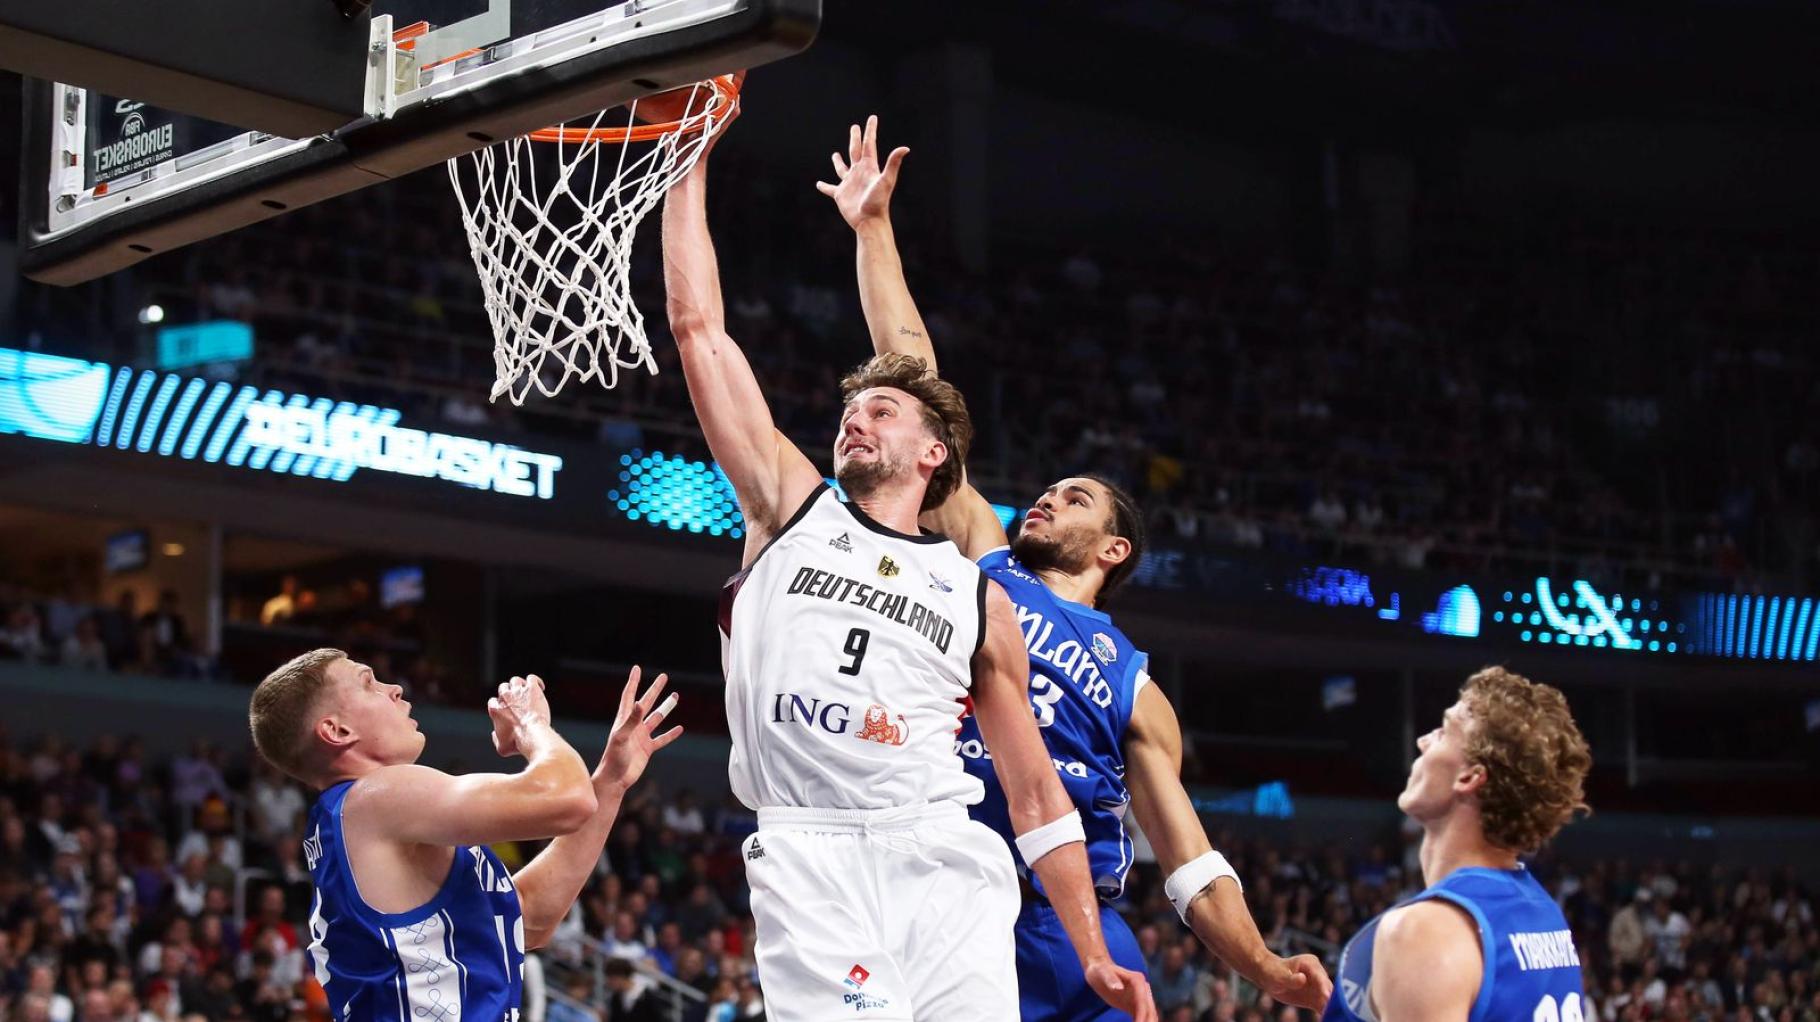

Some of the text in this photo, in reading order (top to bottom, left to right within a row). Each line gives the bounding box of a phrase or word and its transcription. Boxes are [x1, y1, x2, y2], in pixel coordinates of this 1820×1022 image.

[828, 538, 854, 554] PEAK
[787, 567, 955, 655] DEUTSCHLAND
[838, 628, 871, 677] 9
[773, 693, 851, 735] ING
